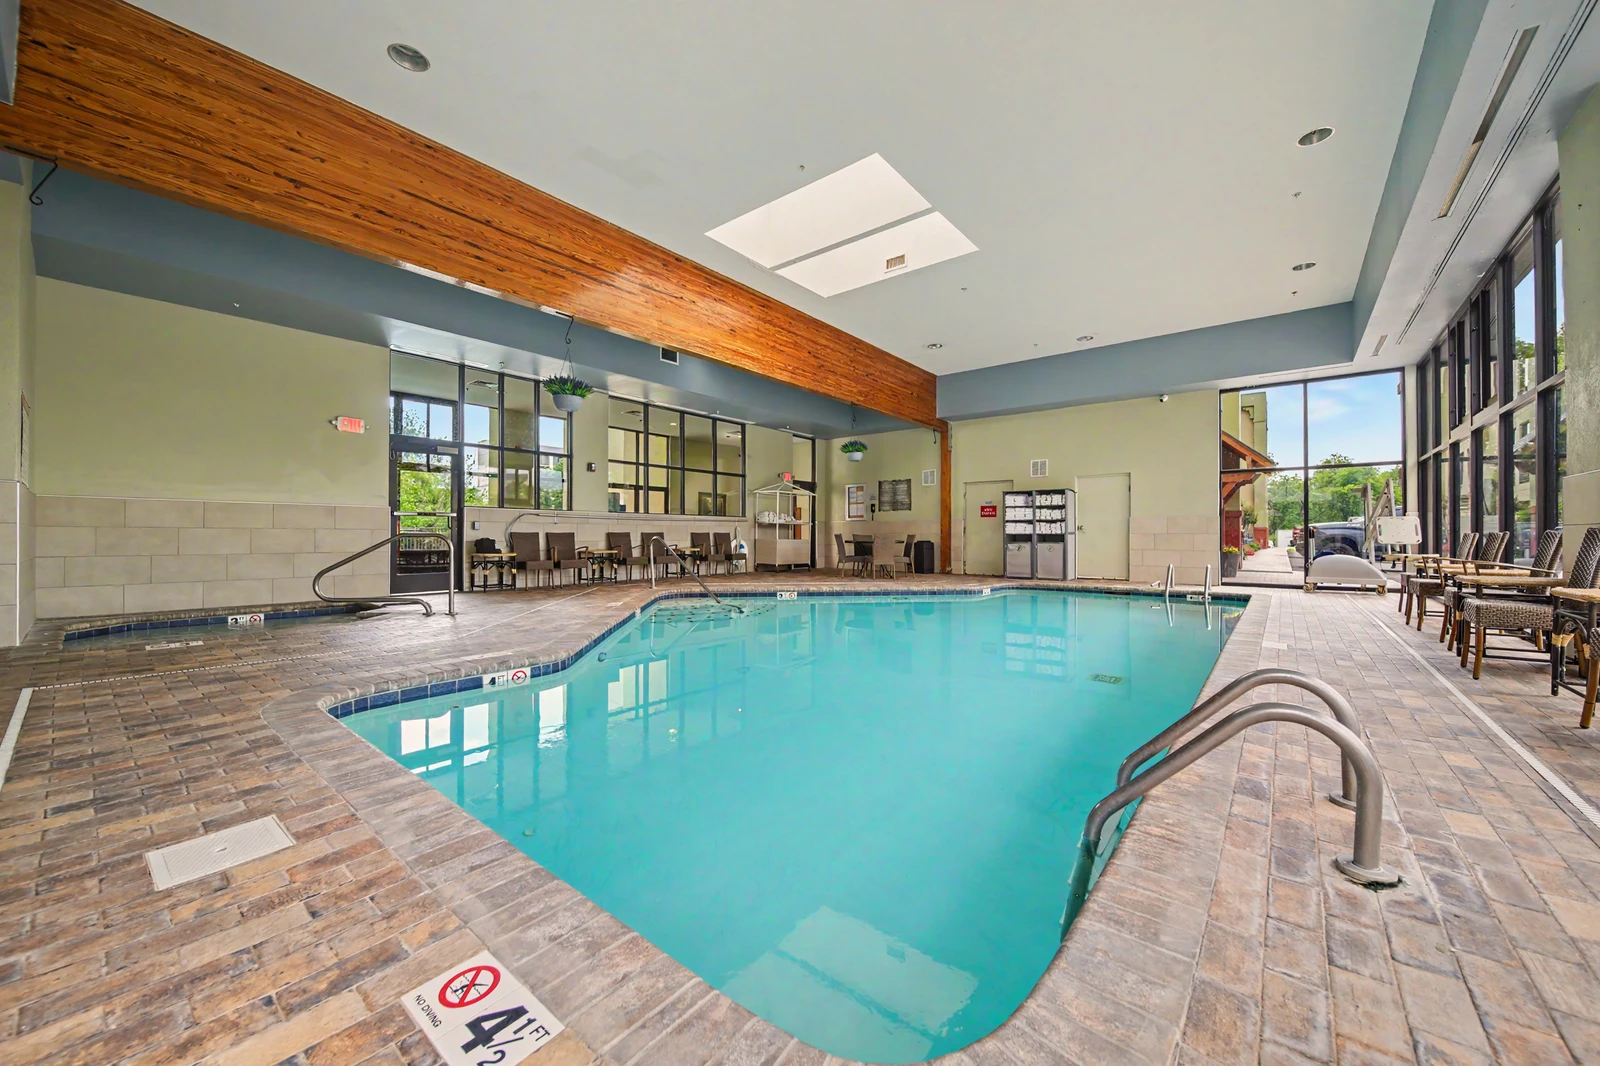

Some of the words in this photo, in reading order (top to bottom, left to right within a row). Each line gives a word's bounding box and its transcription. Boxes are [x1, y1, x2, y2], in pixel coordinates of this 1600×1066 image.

[413, 994, 426, 1006] NO
[421, 1002, 442, 1028] DIVING
[529, 1025, 551, 1042] FT
